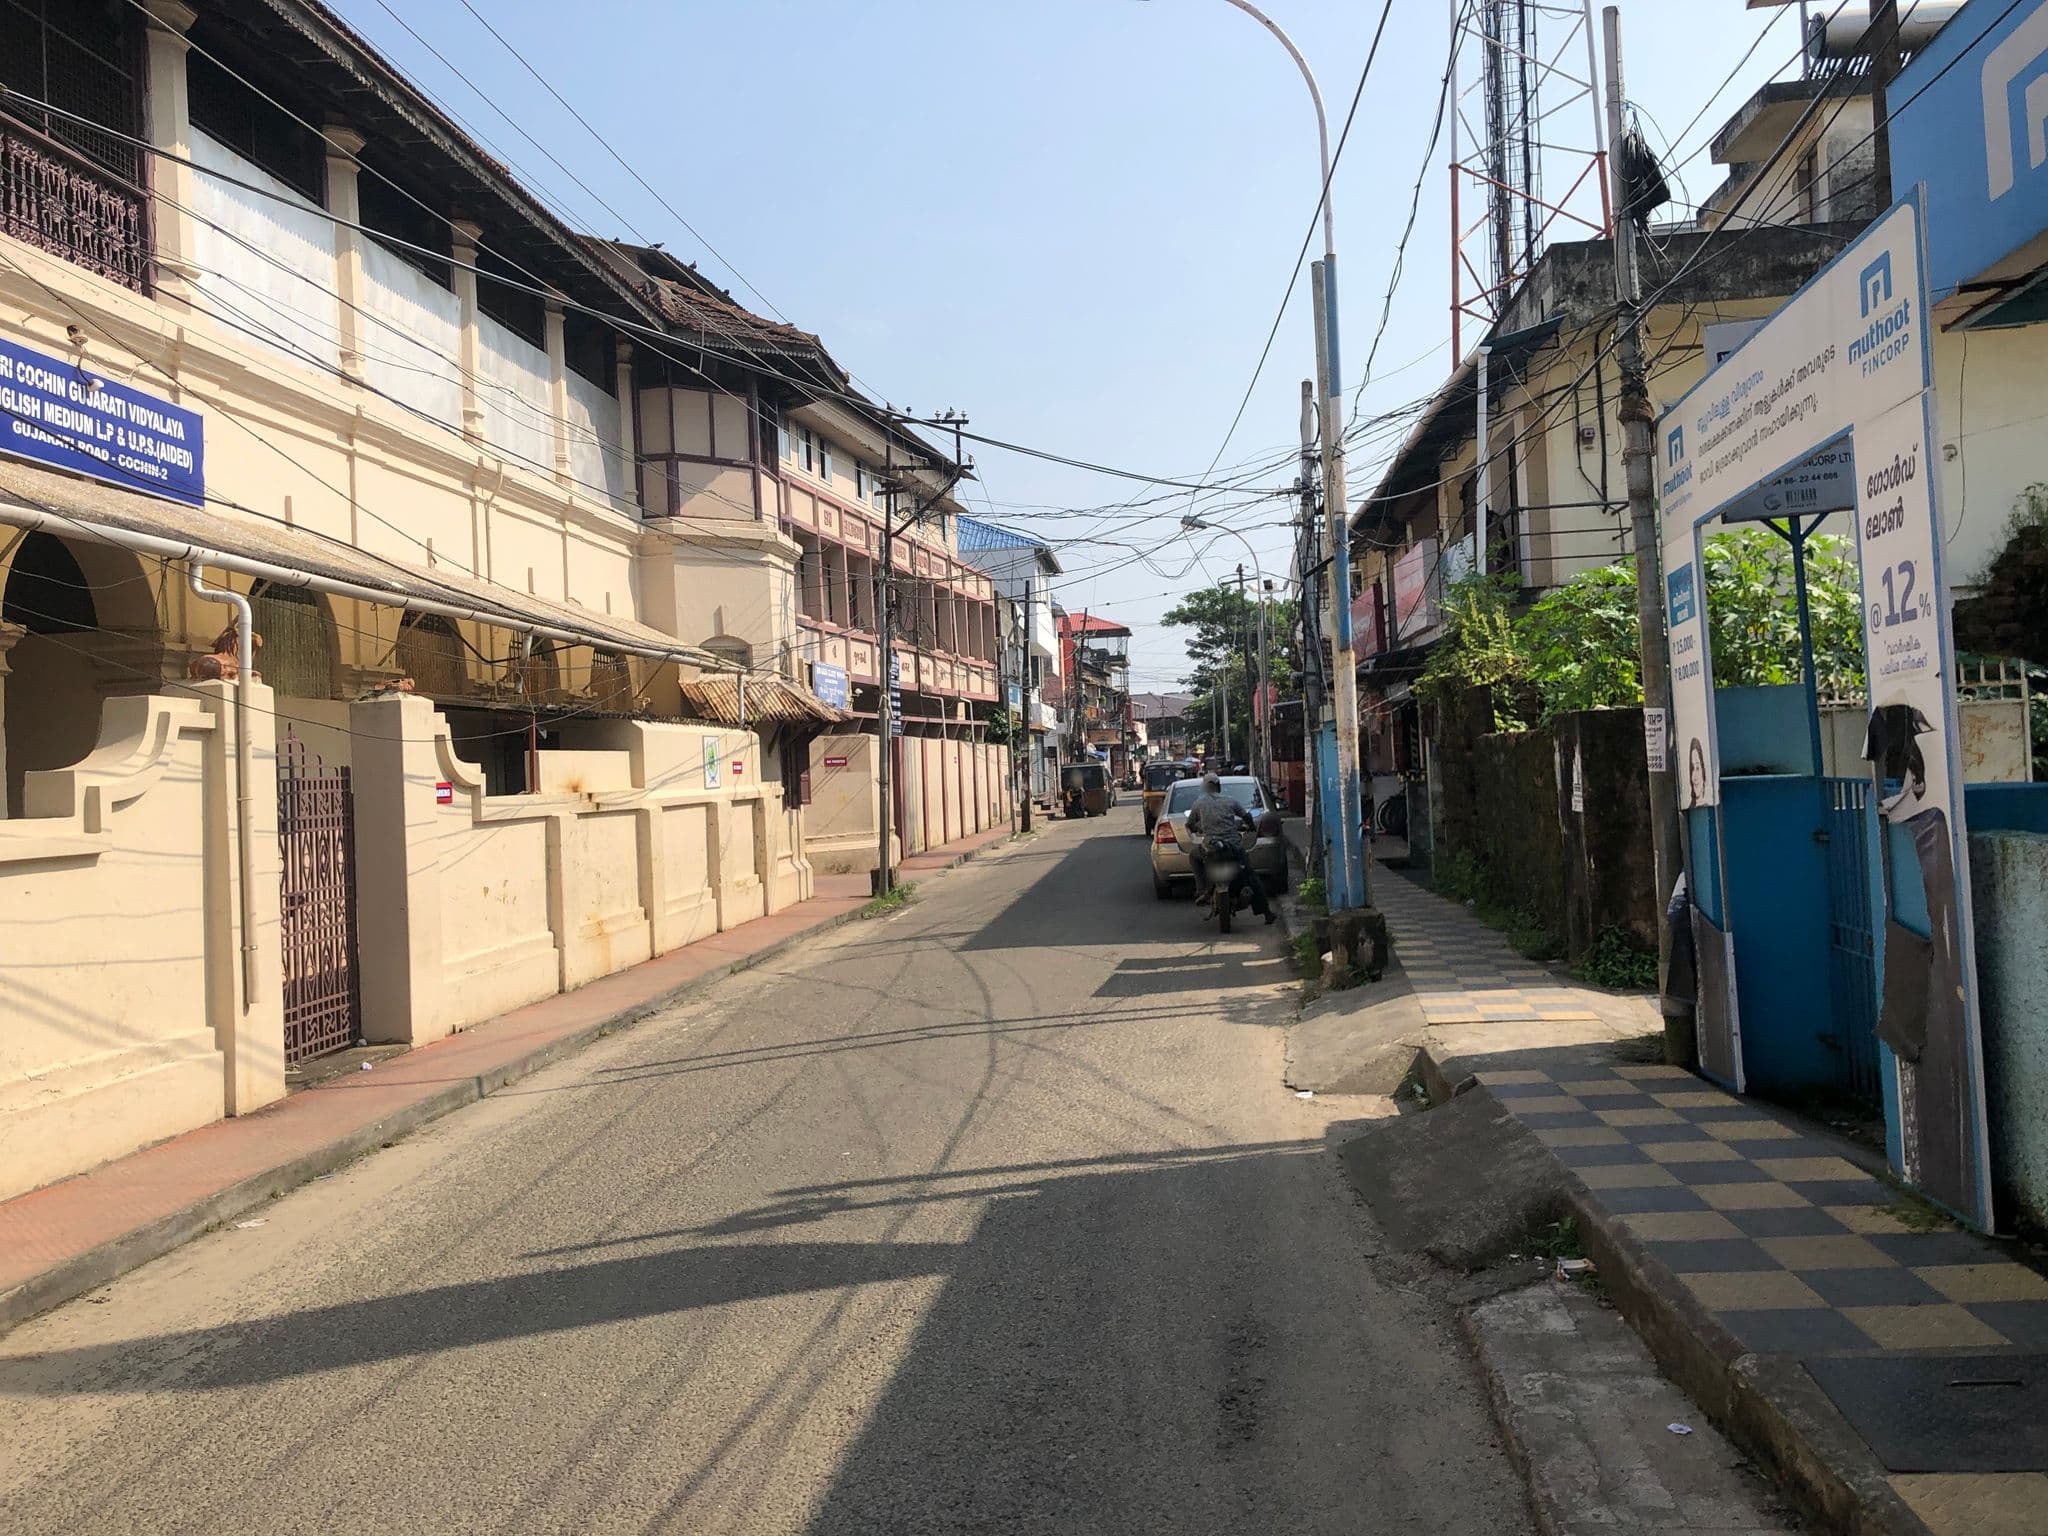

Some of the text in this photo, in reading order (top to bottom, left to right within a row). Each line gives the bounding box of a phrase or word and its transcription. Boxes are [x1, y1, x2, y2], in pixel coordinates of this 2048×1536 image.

[1848, 298, 1910, 366] muthoot
[1862, 333, 1909, 379] FINCORP
[1797, 344, 1835, 383] അവരുടെ
[0, 385, 41, 419] GLISH
[44, 401, 94, 436] MEDIUM
[117, 427, 126, 447] &
[17, 362, 66, 398] COCHIN
[69, 381, 126, 419] GUJARATI
[128, 402, 185, 441] VIDYALAYA
[12, 420, 75, 451] GUJARATI
[77, 439, 110, 461] ROAD
[118, 454, 168, 480] COCHIN-2
[1866, 443, 1919, 499] ഗോൾഡ്
[1865, 495, 1905, 541] ലോൺ
